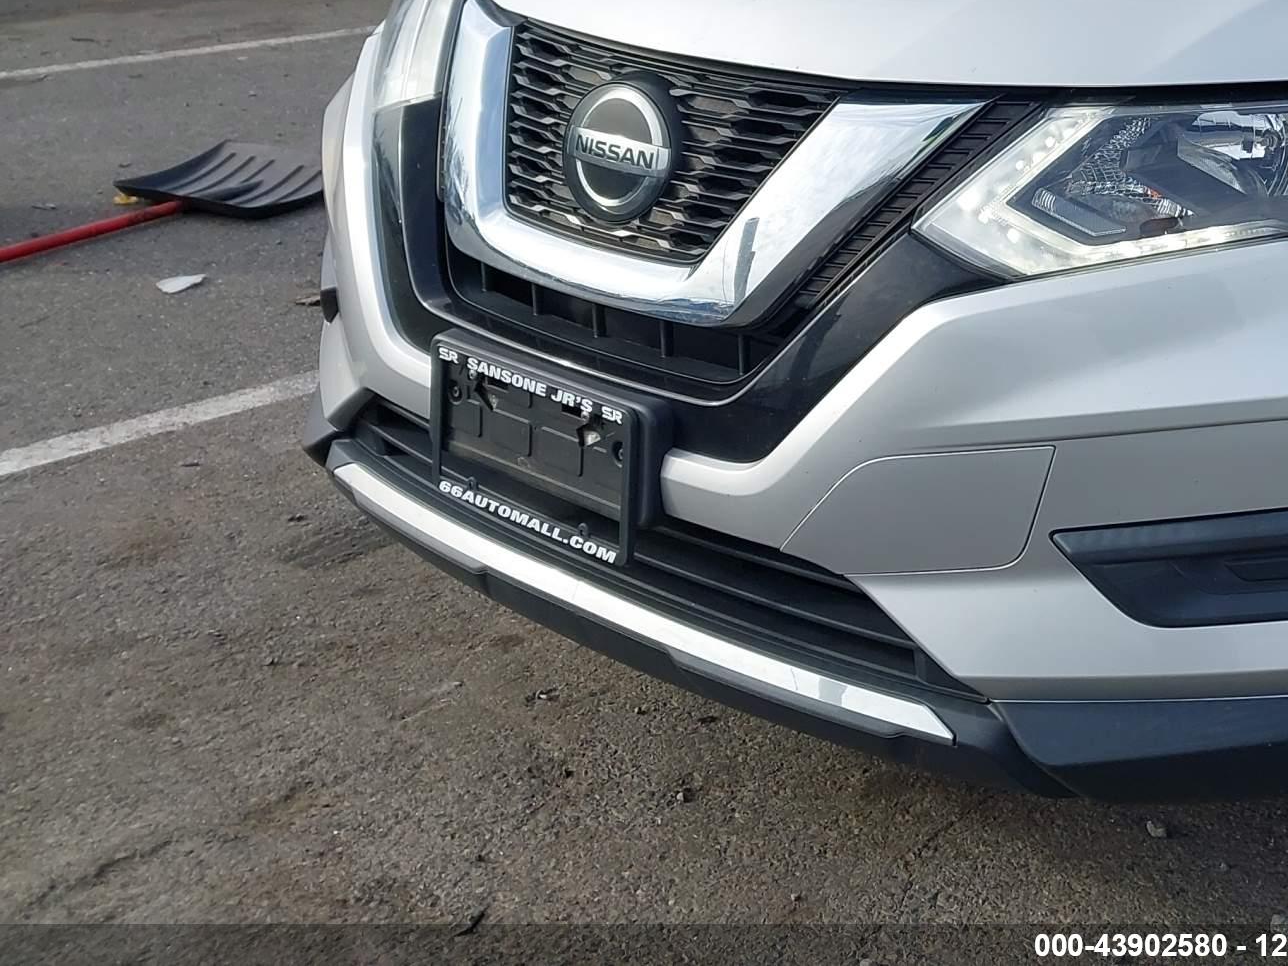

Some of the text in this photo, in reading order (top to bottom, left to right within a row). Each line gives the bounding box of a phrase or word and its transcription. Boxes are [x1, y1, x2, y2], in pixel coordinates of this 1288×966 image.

[575, 135, 654, 169] NISSAN
[438, 346, 623, 425] SR SANSONE JR'S SR
[438, 480, 616, 564] 66AUTOMALL.COM
